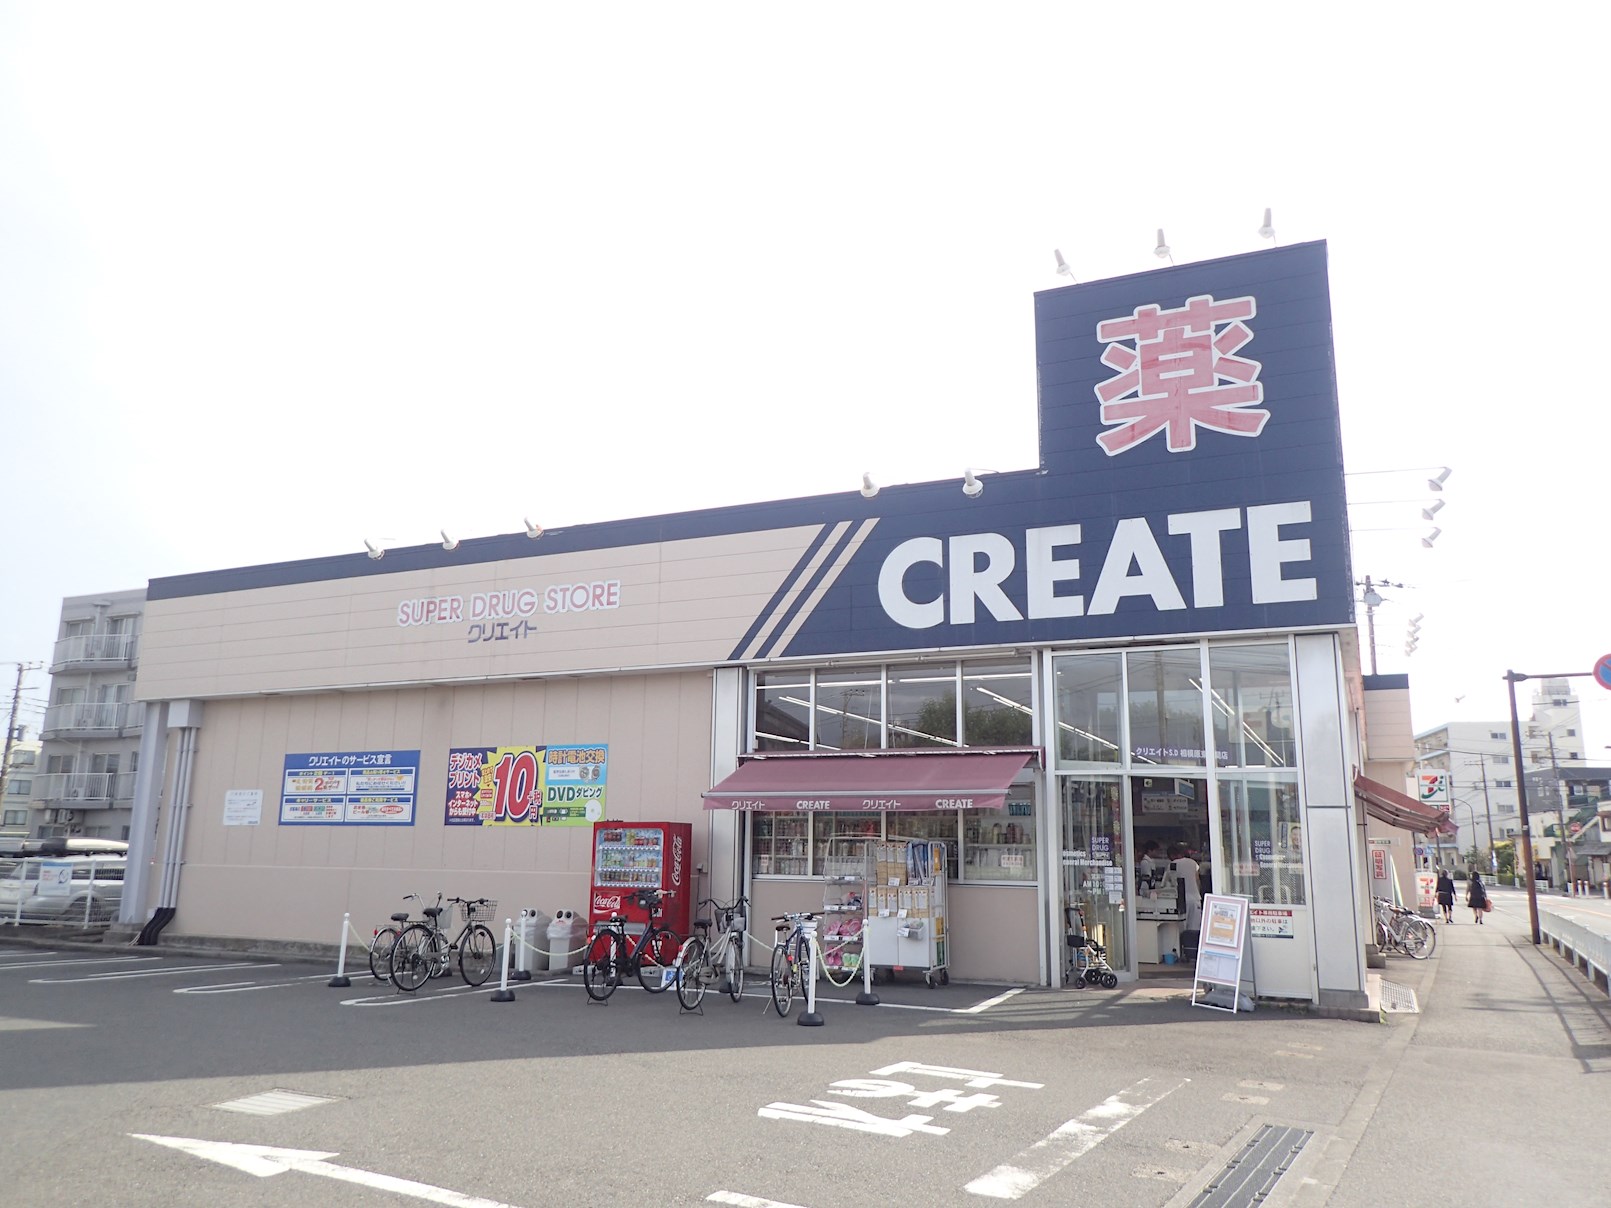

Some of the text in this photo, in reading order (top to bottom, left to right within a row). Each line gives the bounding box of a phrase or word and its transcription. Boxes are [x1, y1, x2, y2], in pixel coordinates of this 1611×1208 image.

[1094, 294, 1271, 457] 薬
[878, 500, 1318, 629] CREATE
[399, 579, 621, 627] SUPER DRUG STORE
[467, 620, 537, 643] クリエイト
[309, 754, 392, 766] クリエイトのサービス宣言
[449, 752, 482, 771] デジカメ
[548, 749, 606, 764] 時計電池交換
[449, 770, 481, 788] プリント
[494, 752, 537, 818] 10
[448, 800, 479, 808] インターネット
[731, 800, 765, 811] クリエイト
[796, 800, 830, 810] CREATE
[862, 799, 902, 810] クリエイト
[935, 798, 973, 809] CREATE
[529, 805, 538, 819] 円
[1091, 836, 1109, 844] SUPER
[757, 1061, 1046, 1138] 止まれ
